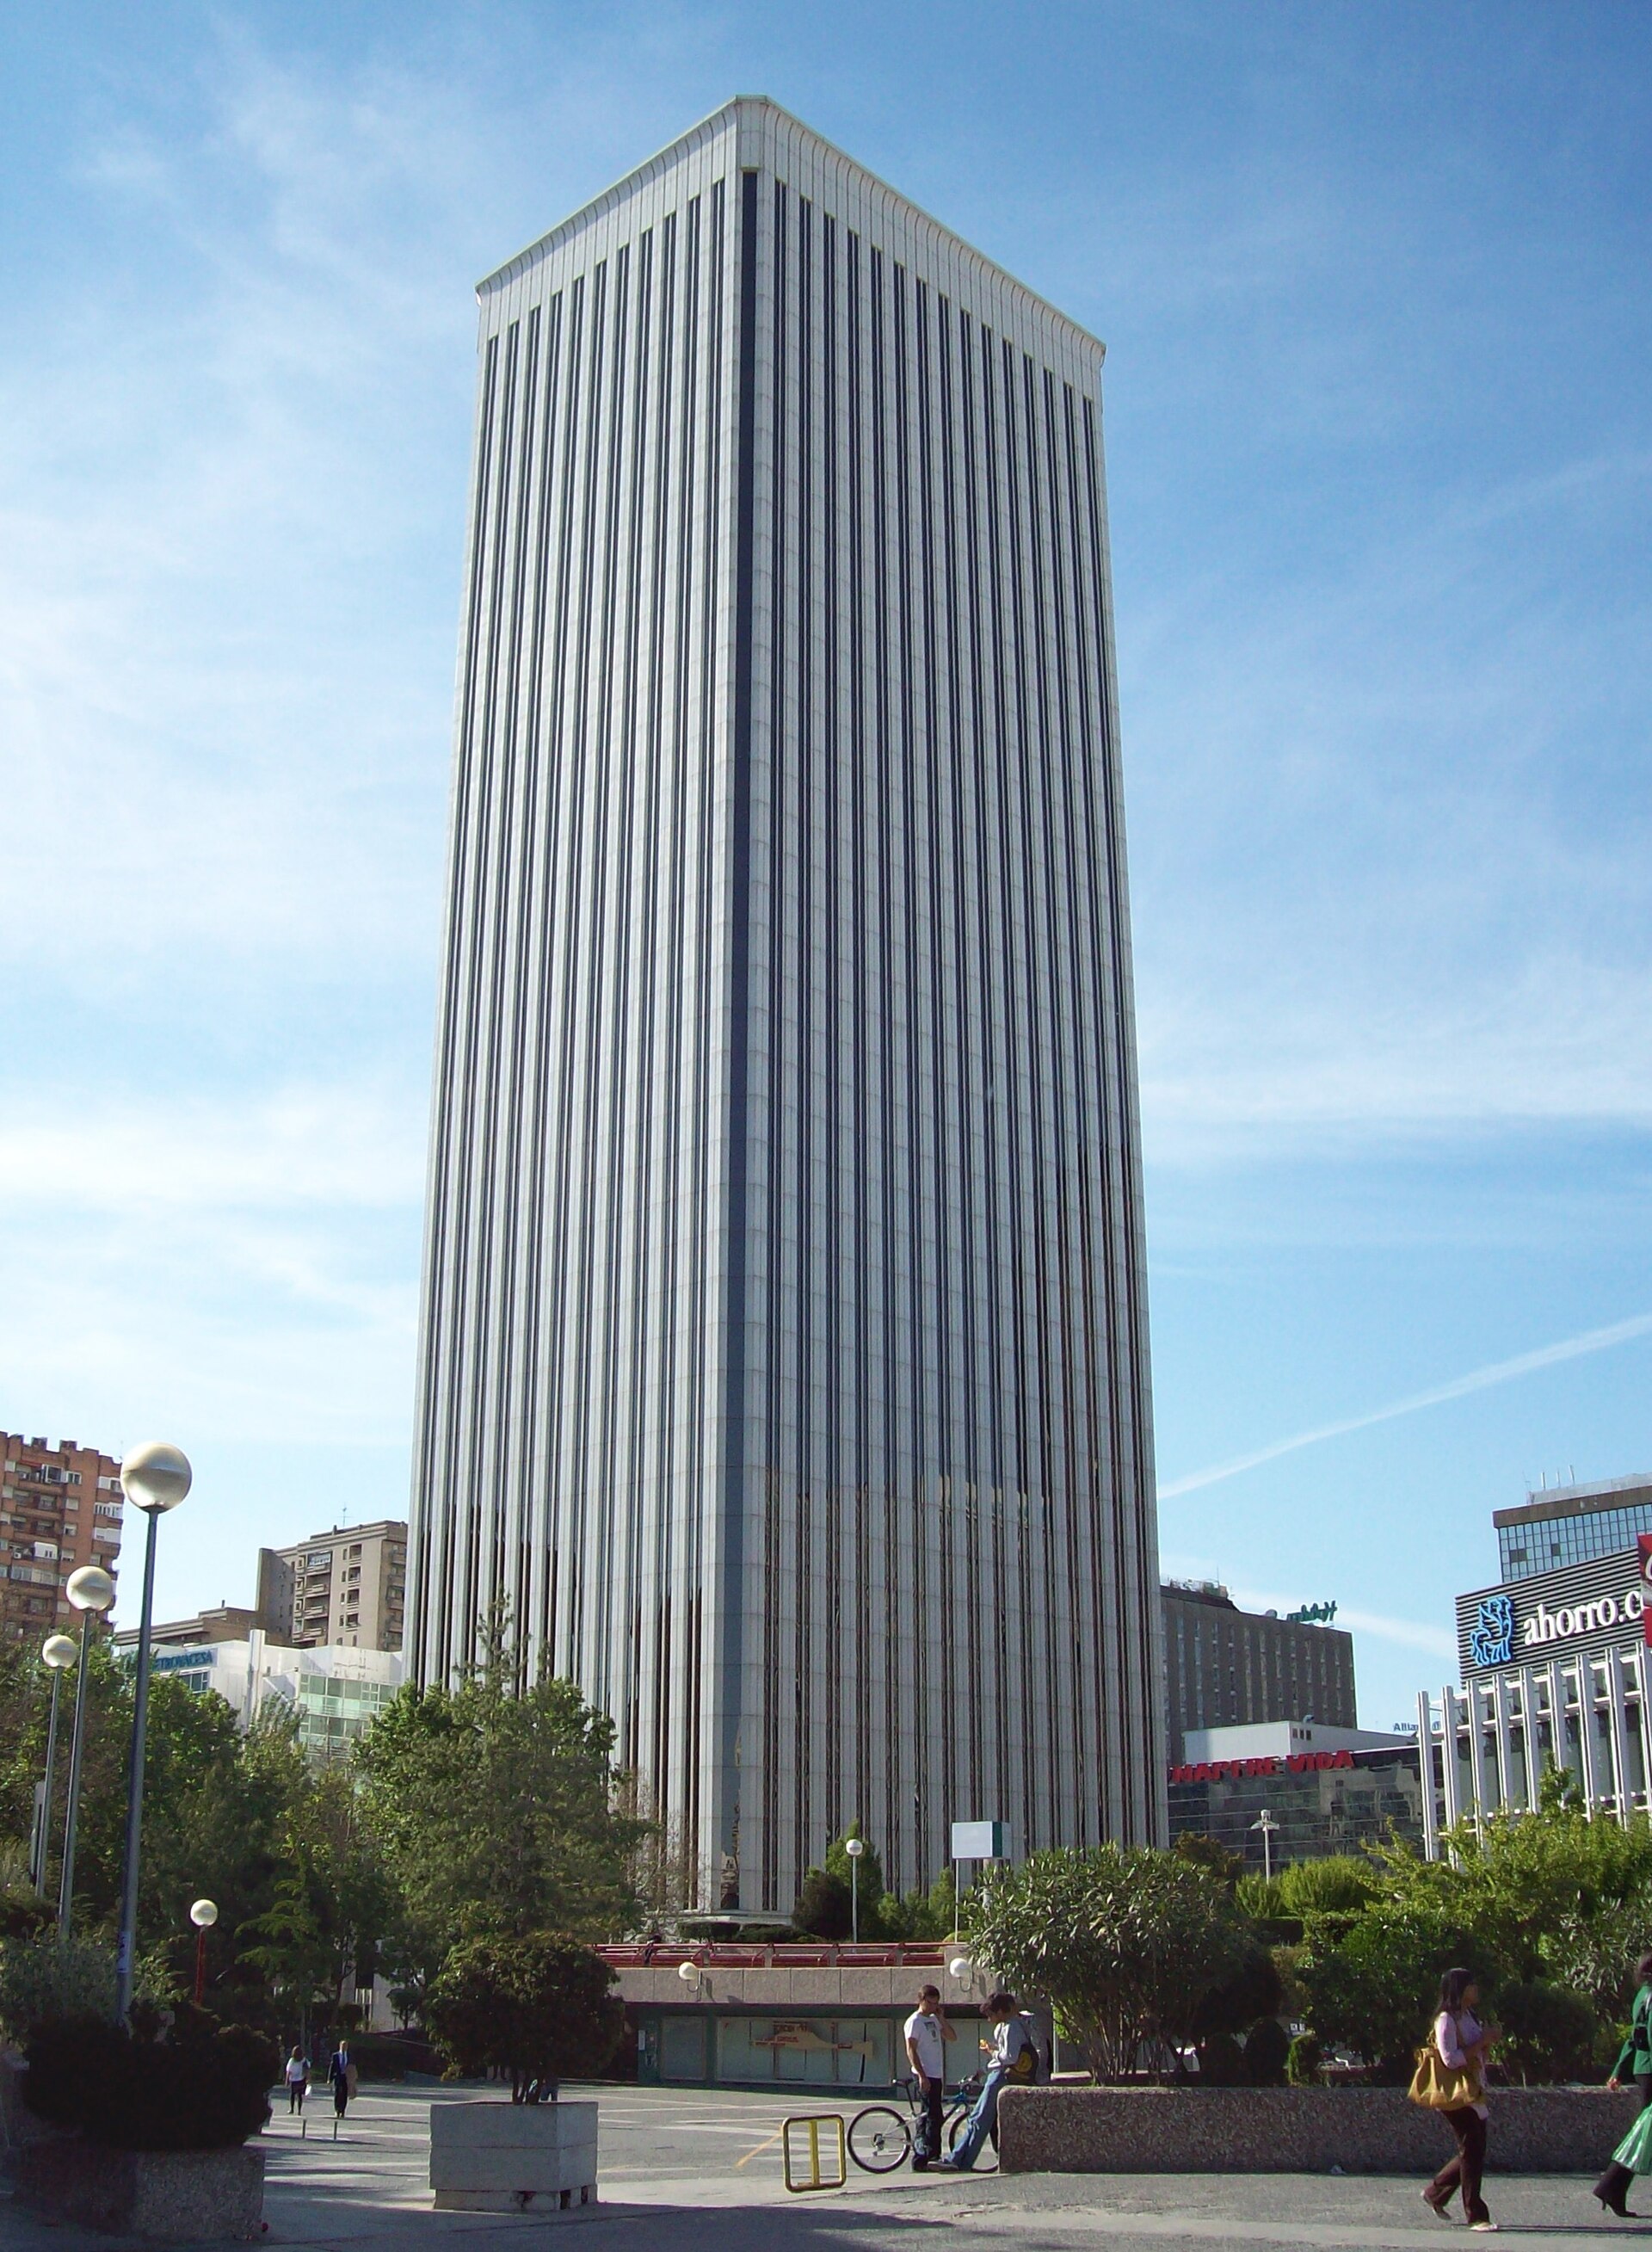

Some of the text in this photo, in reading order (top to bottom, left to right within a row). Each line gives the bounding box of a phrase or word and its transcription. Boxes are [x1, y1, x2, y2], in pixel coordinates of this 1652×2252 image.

[1524, 1590, 1643, 1645] ahorro.c
[154, 1650, 213, 1669] ETROVACESA
[1393, 1722, 1419, 1731] Allia
[1169, 1749, 1354, 1783] MAPFRE VIDA
